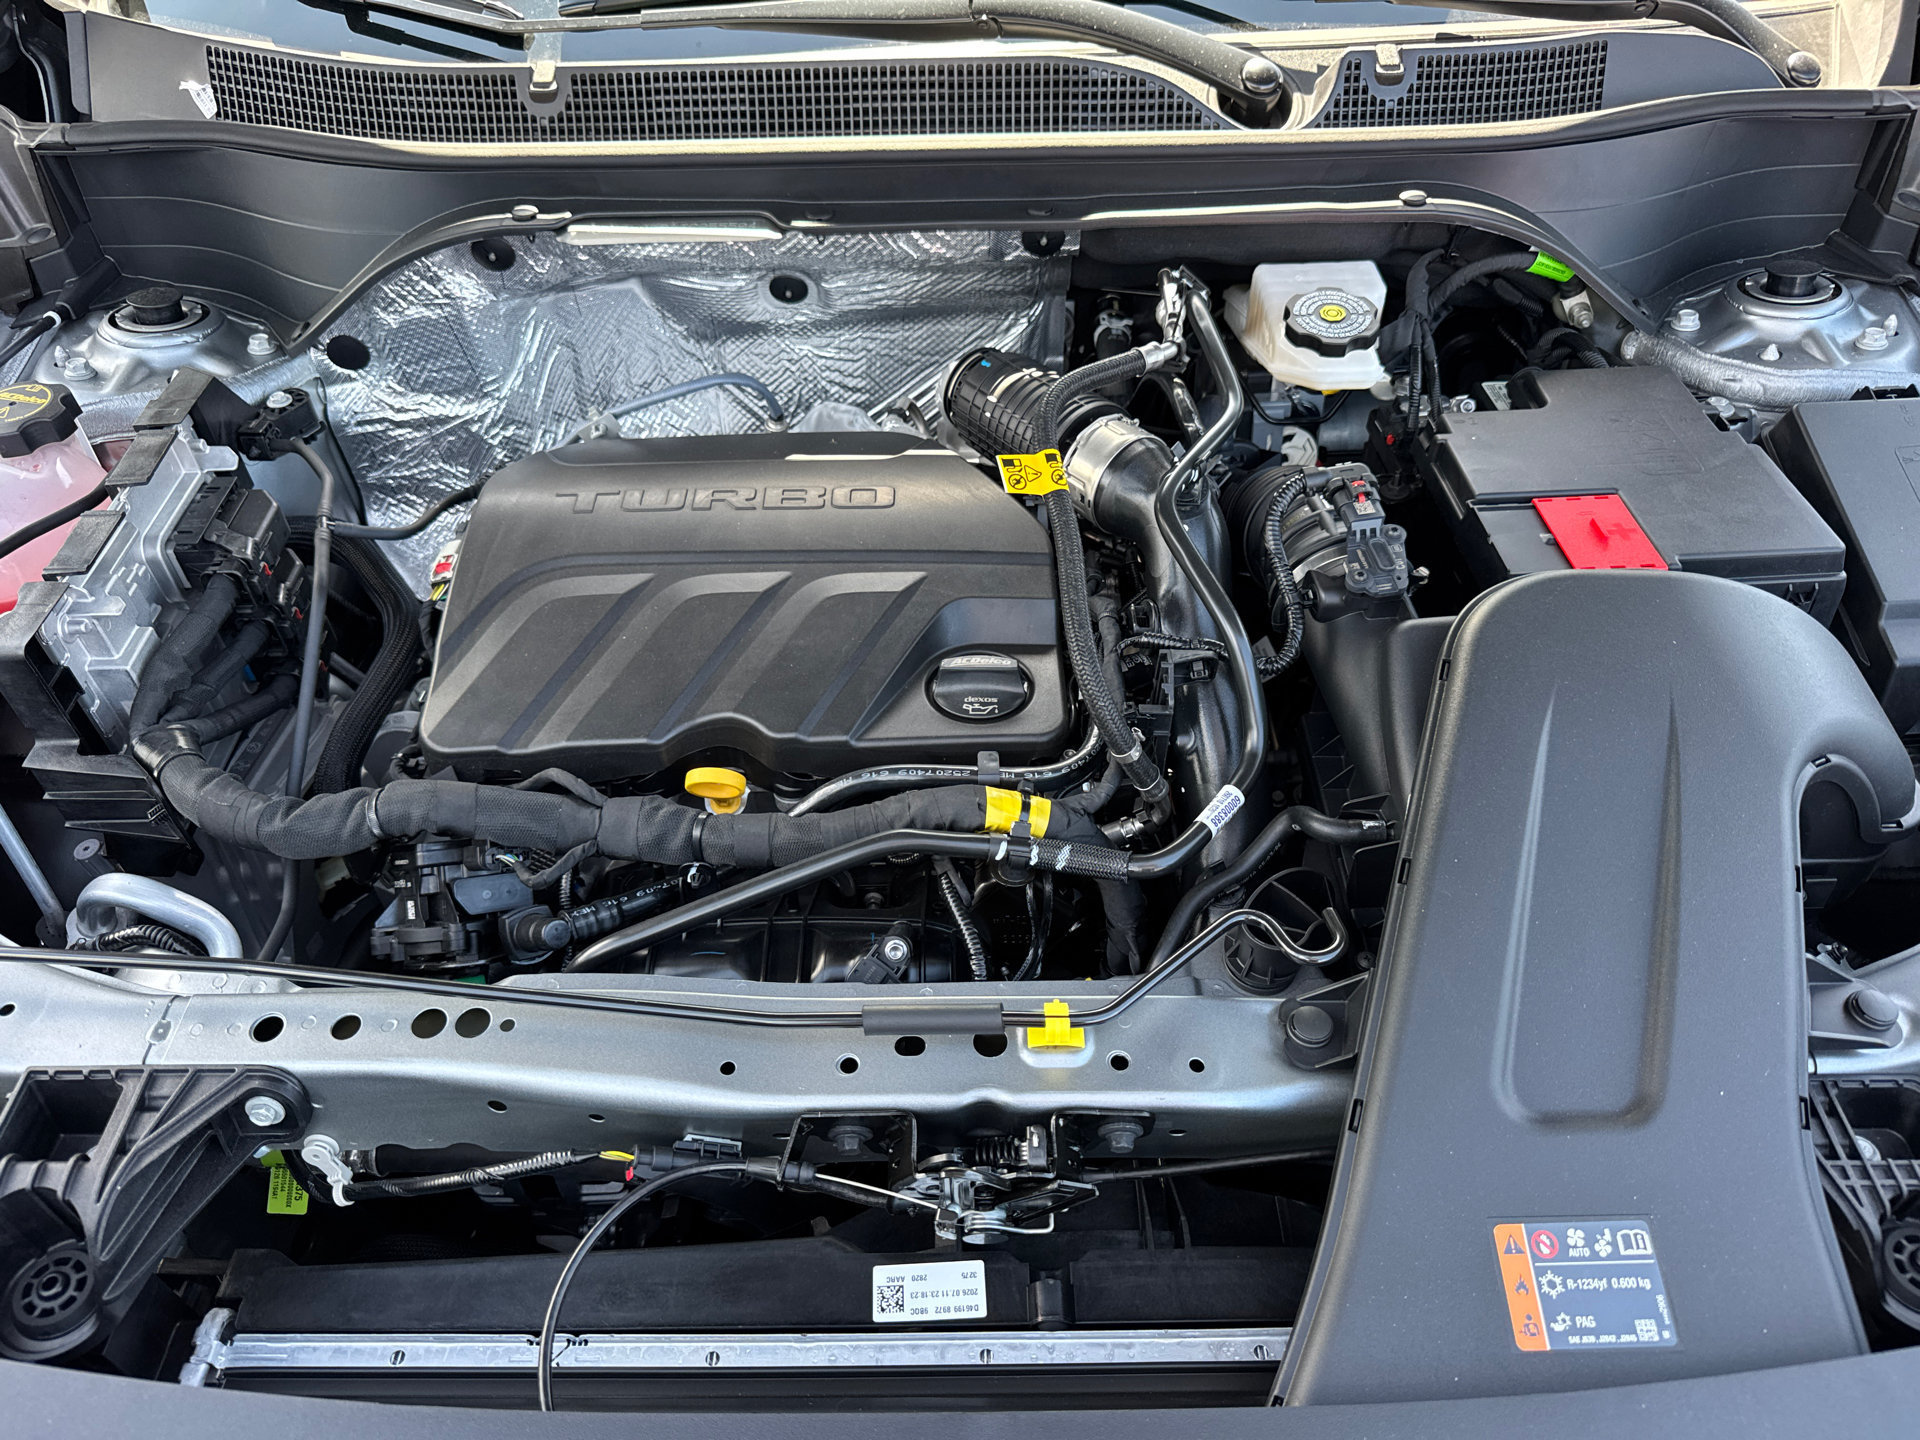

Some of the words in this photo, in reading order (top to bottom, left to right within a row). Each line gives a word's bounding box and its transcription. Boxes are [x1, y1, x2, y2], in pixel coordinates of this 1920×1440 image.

[555, 485, 896, 514] TURBO
[951, 656, 1012, 666] ACDelco
[898, 768, 972, 778] 25207409
[1568, 1247, 1590, 1258] AUTO
[1566, 1277, 1608, 1291] R-1234yf
[1611, 1277, 1637, 1289] 0.600
[1637, 1276, 1652, 1290] kg
[1575, 1315, 1597, 1328] PAG
